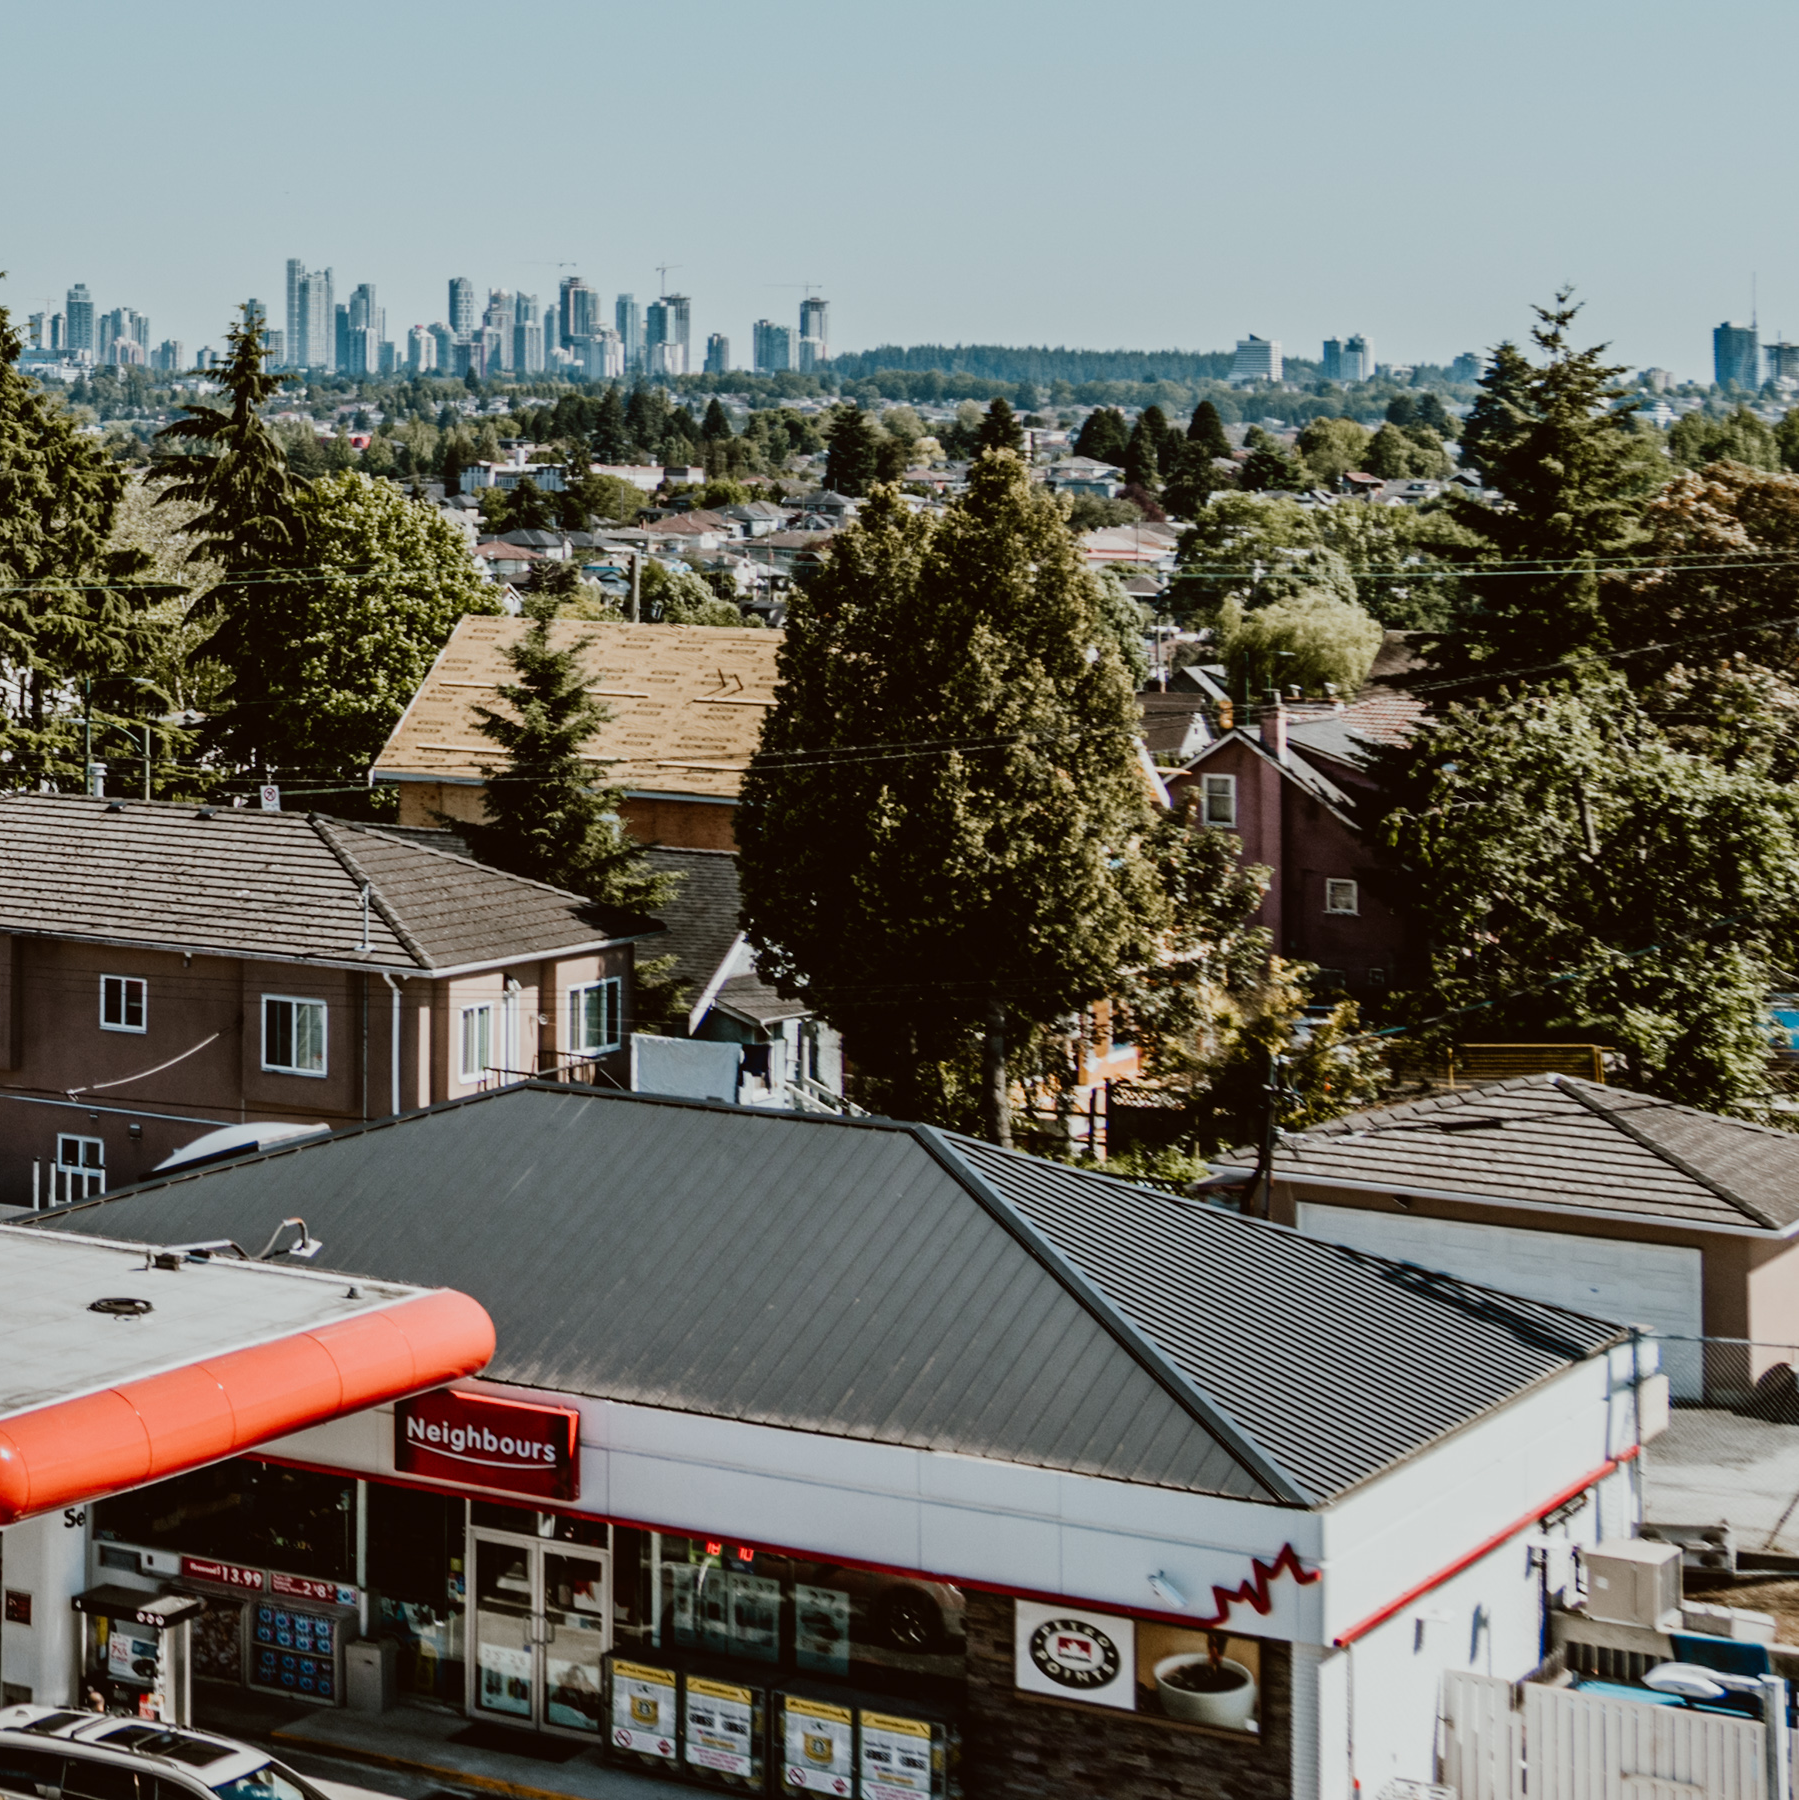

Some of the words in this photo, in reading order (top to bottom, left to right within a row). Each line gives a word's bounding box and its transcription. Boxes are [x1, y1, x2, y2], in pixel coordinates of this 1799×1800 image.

[407, 1416, 556, 1462] Neighbours
[1041, 1620, 1111, 1648] PETRO
[1036, 1650, 1115, 1683] POINTS
